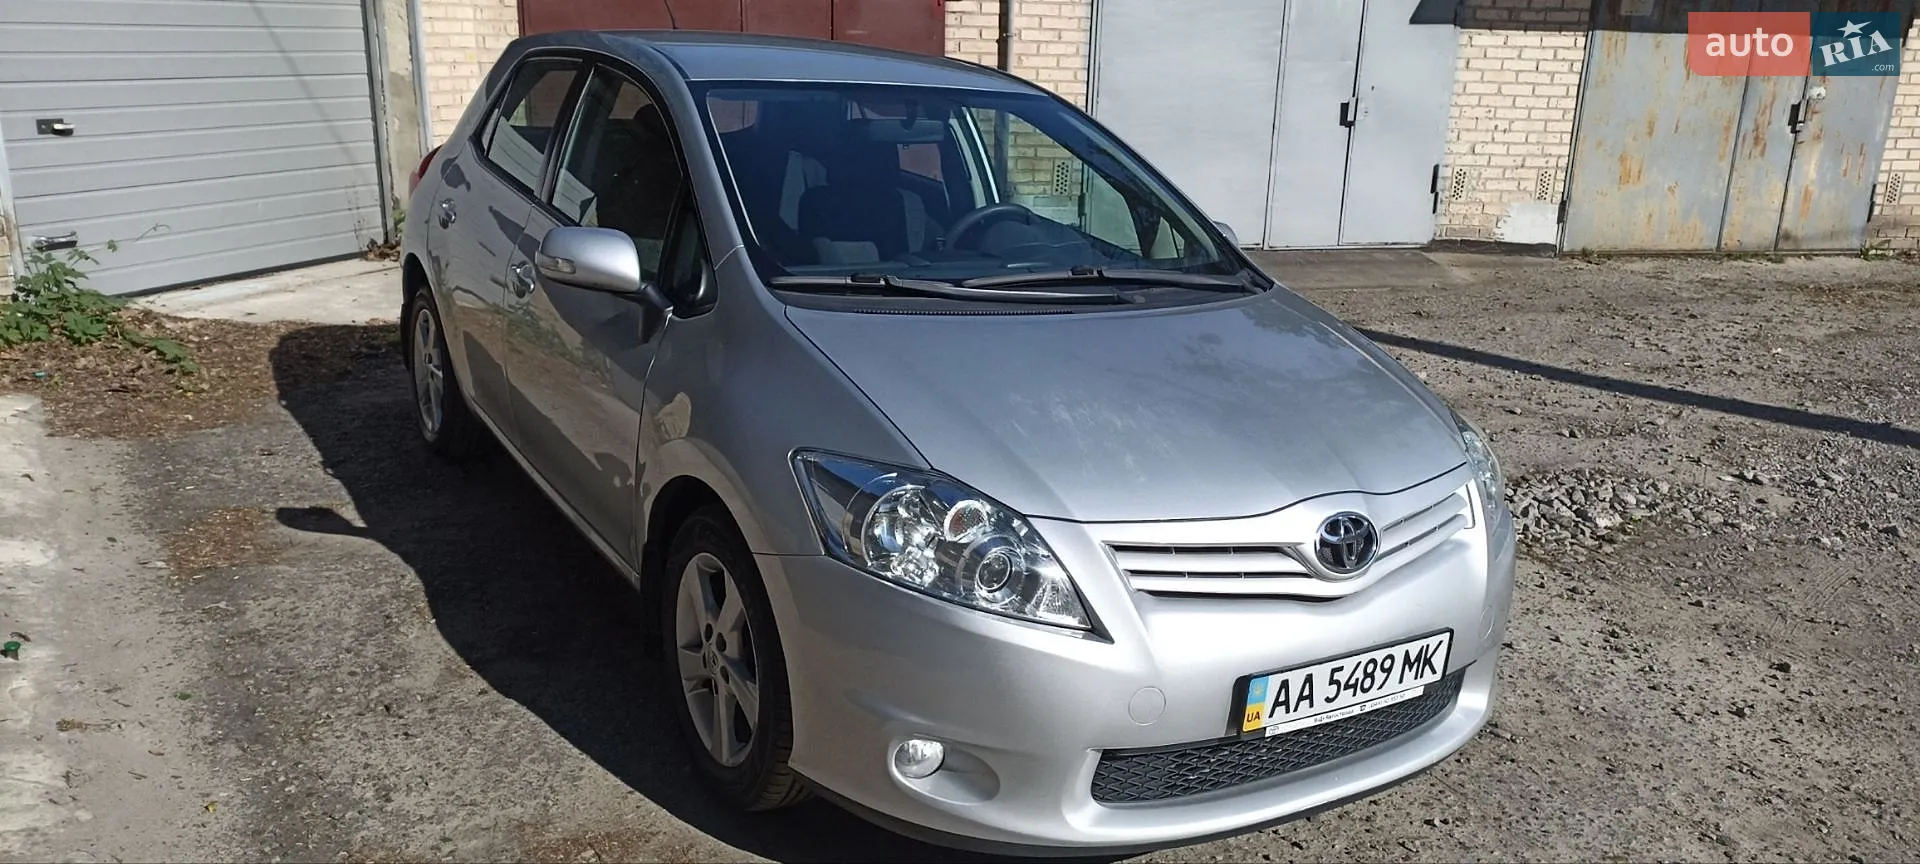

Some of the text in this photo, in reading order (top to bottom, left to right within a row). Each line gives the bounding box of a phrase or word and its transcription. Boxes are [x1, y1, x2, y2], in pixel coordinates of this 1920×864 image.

[1268, 673, 1315, 719] AA
[1324, 653, 1395, 704] 5489
[1398, 640, 1444, 685] MK
[1246, 711, 1261, 723] UA
